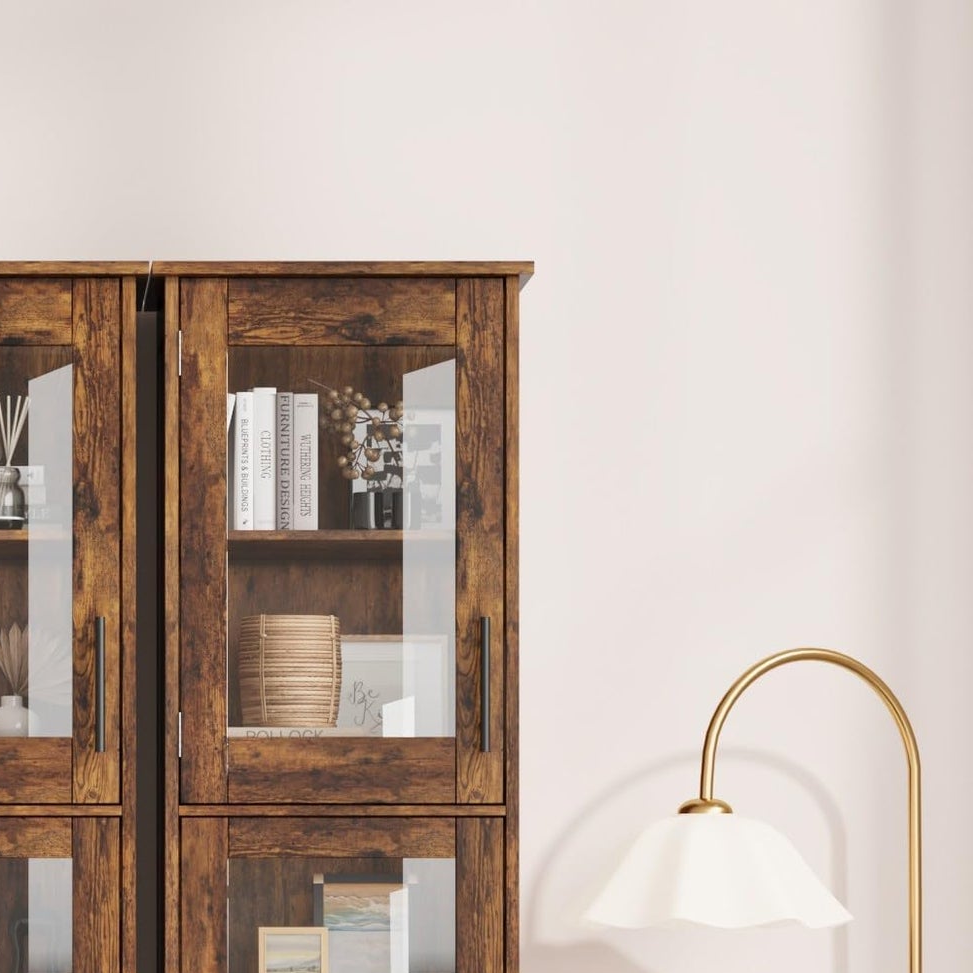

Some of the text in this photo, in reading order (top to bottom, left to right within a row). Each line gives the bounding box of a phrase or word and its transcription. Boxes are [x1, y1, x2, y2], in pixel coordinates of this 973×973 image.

[240, 418, 249, 464] BLUEPRINTS
[259, 430, 271, 479] CLOTHING
[280, 395, 291, 530] FURNITURE DESIGN
[240, 473, 249, 512] BUILDINGS
[299, 434, 312, 517] WUTHERING HEIGHTS
